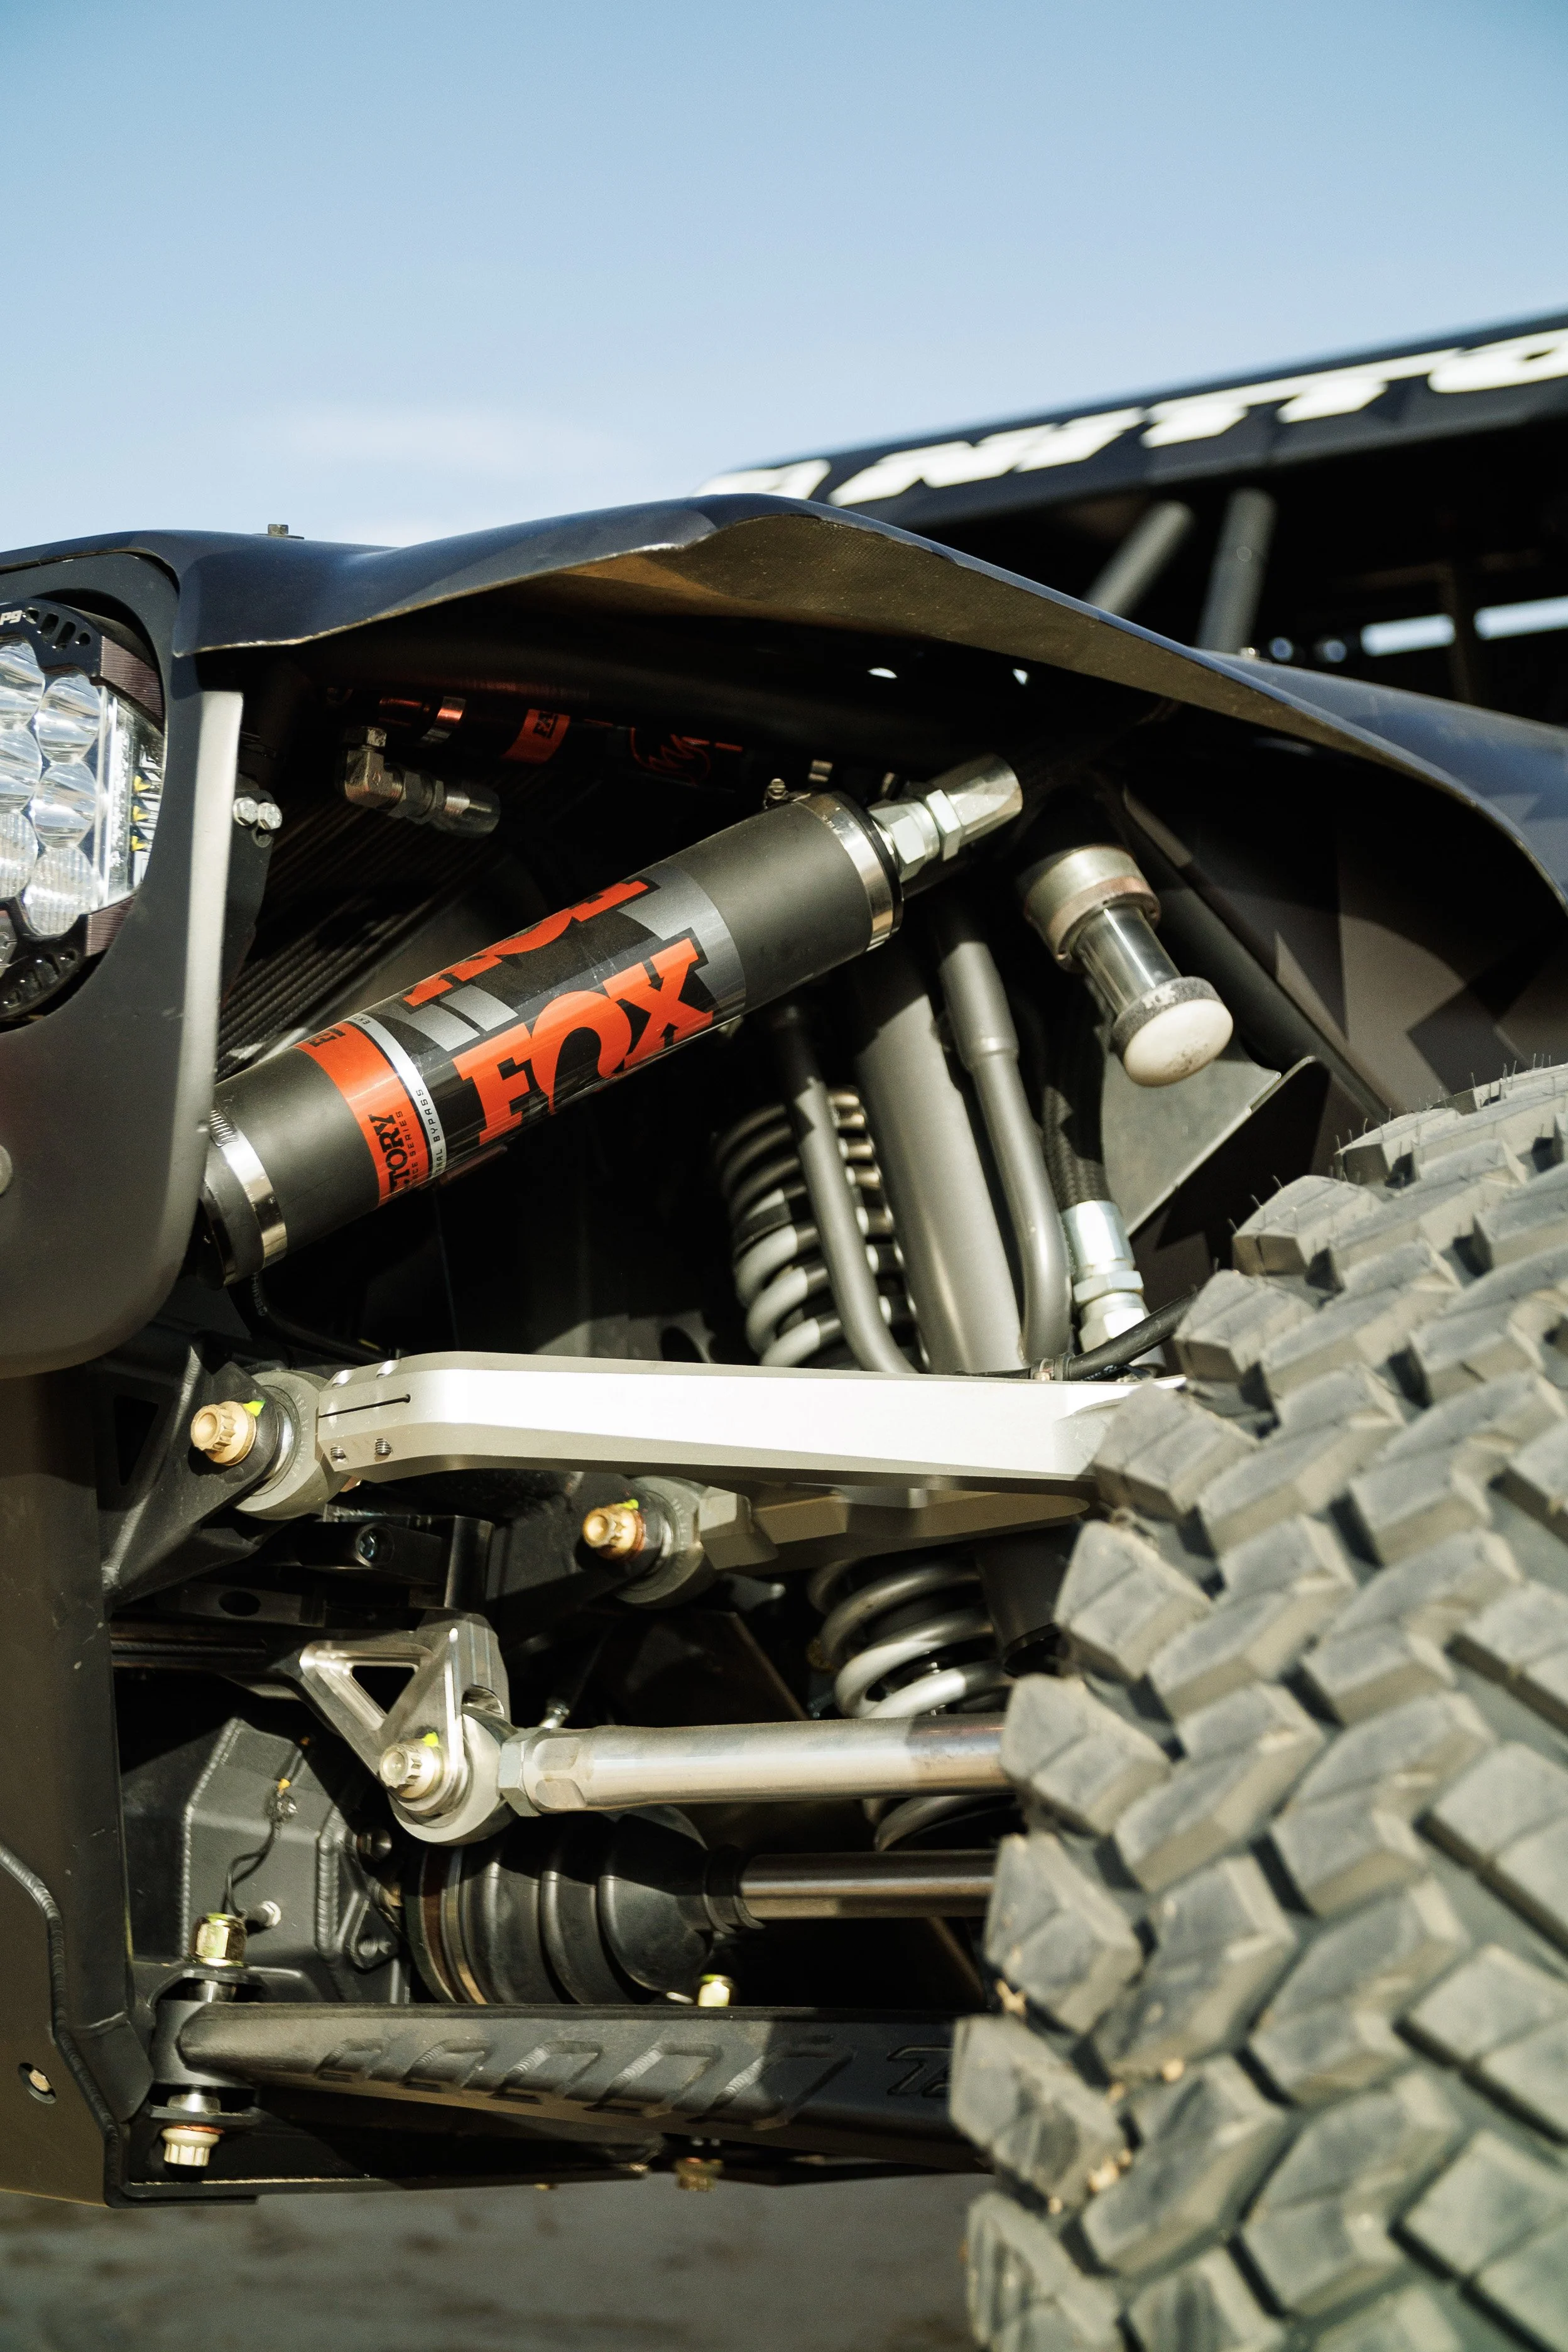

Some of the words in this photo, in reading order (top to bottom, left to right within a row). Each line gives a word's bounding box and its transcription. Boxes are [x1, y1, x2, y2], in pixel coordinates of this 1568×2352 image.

[828, 327, 1568, 507] NITTO
[451, 937, 714, 1146] FOX
[396, 1110, 417, 1157] SERIES
[416, 1089, 441, 1143] BYPASS
[368, 1114, 411, 1192] TORY
[295, 1393, 307, 1413] USA
